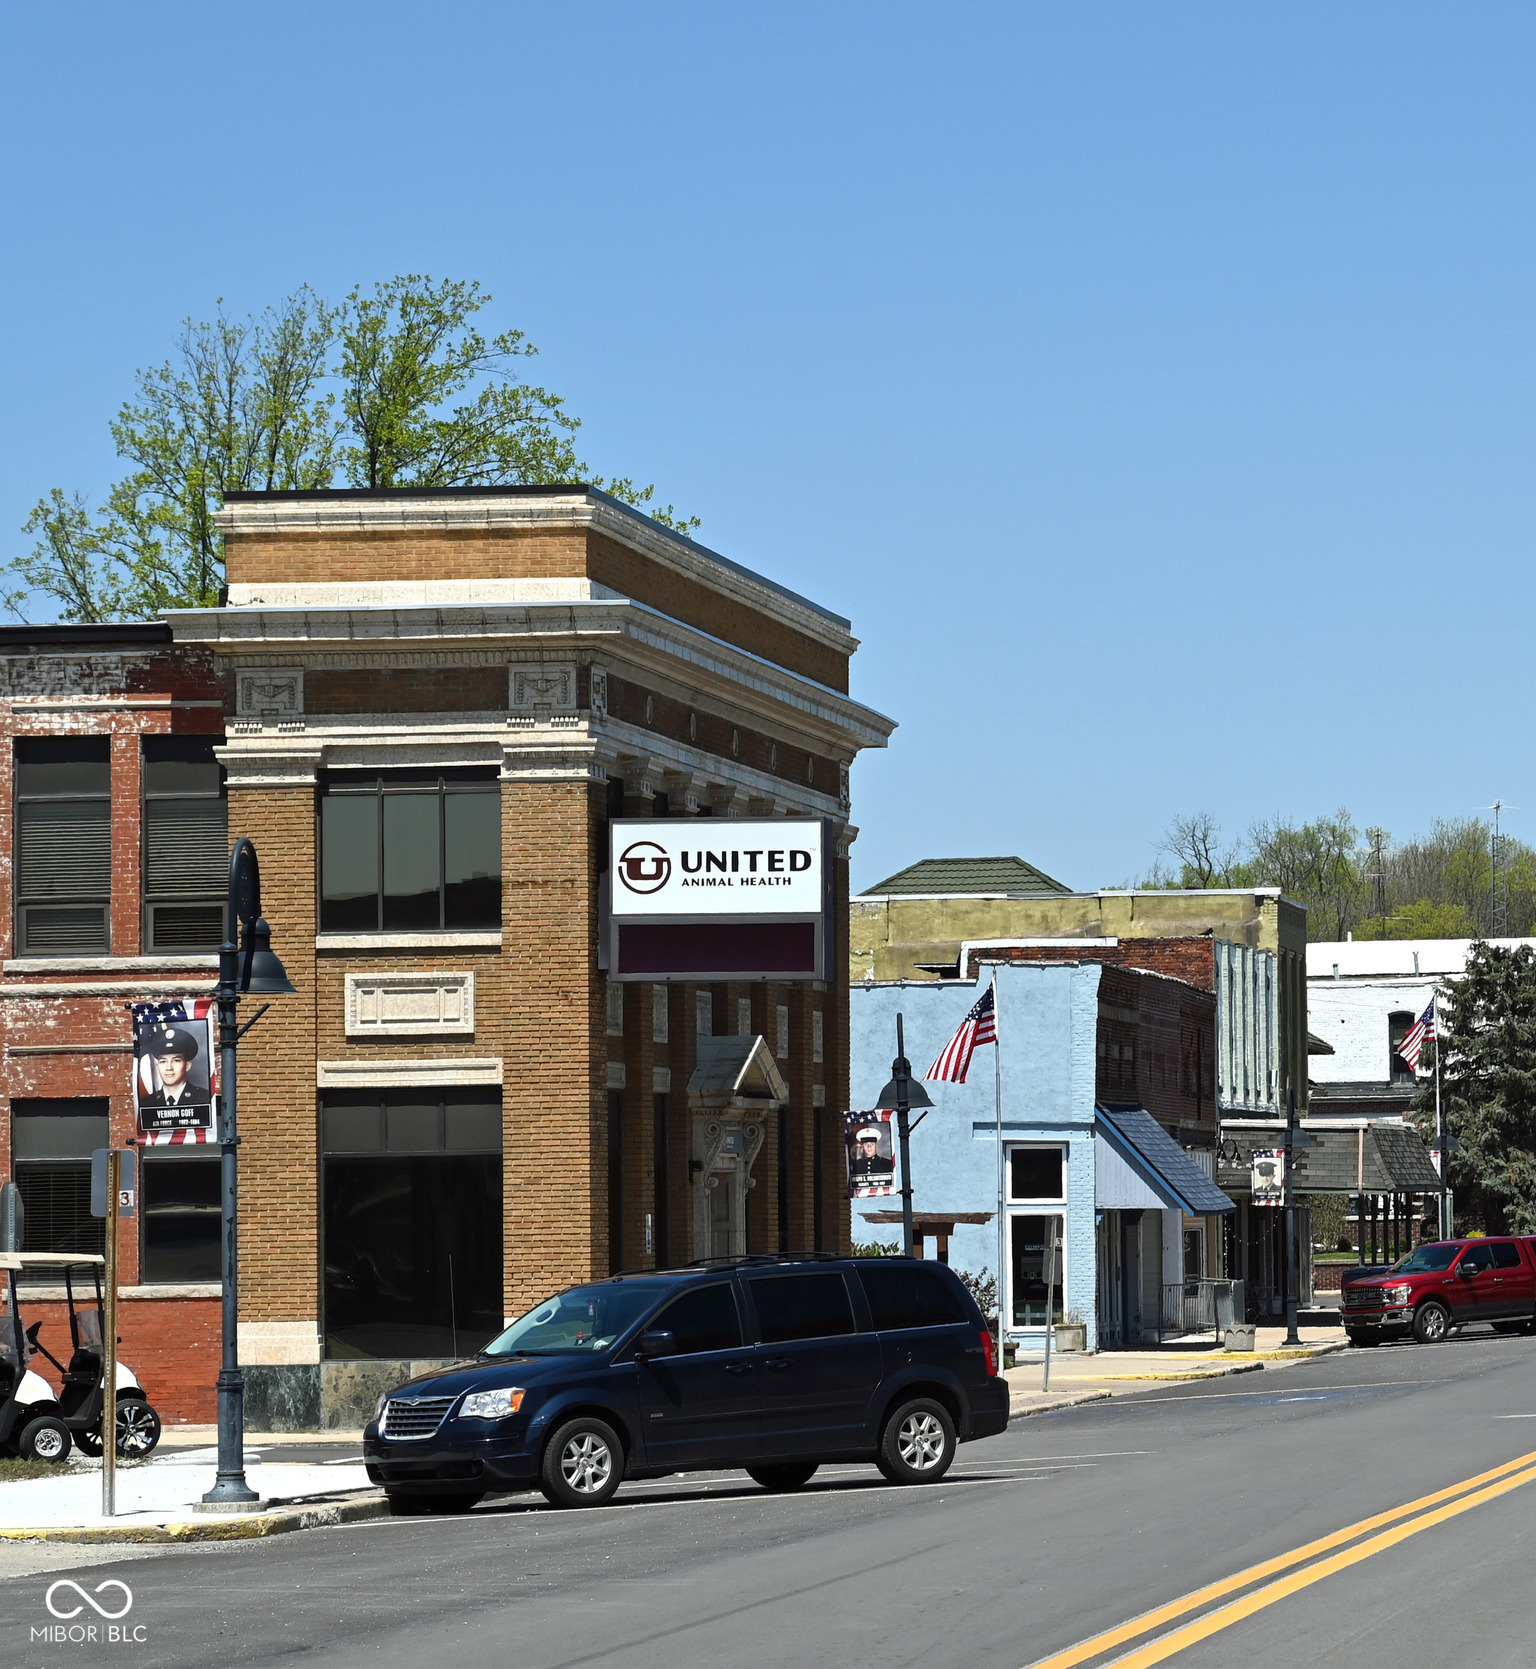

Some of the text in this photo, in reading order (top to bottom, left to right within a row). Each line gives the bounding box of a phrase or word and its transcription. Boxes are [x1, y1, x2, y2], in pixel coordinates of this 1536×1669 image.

[681, 850, 812, 873] UNITED
[681, 876, 792, 887] ANIMAL HEALTH
[156, 1108, 195, 1119] VERNON GOFF
[120, 1191, 130, 1206] 3
